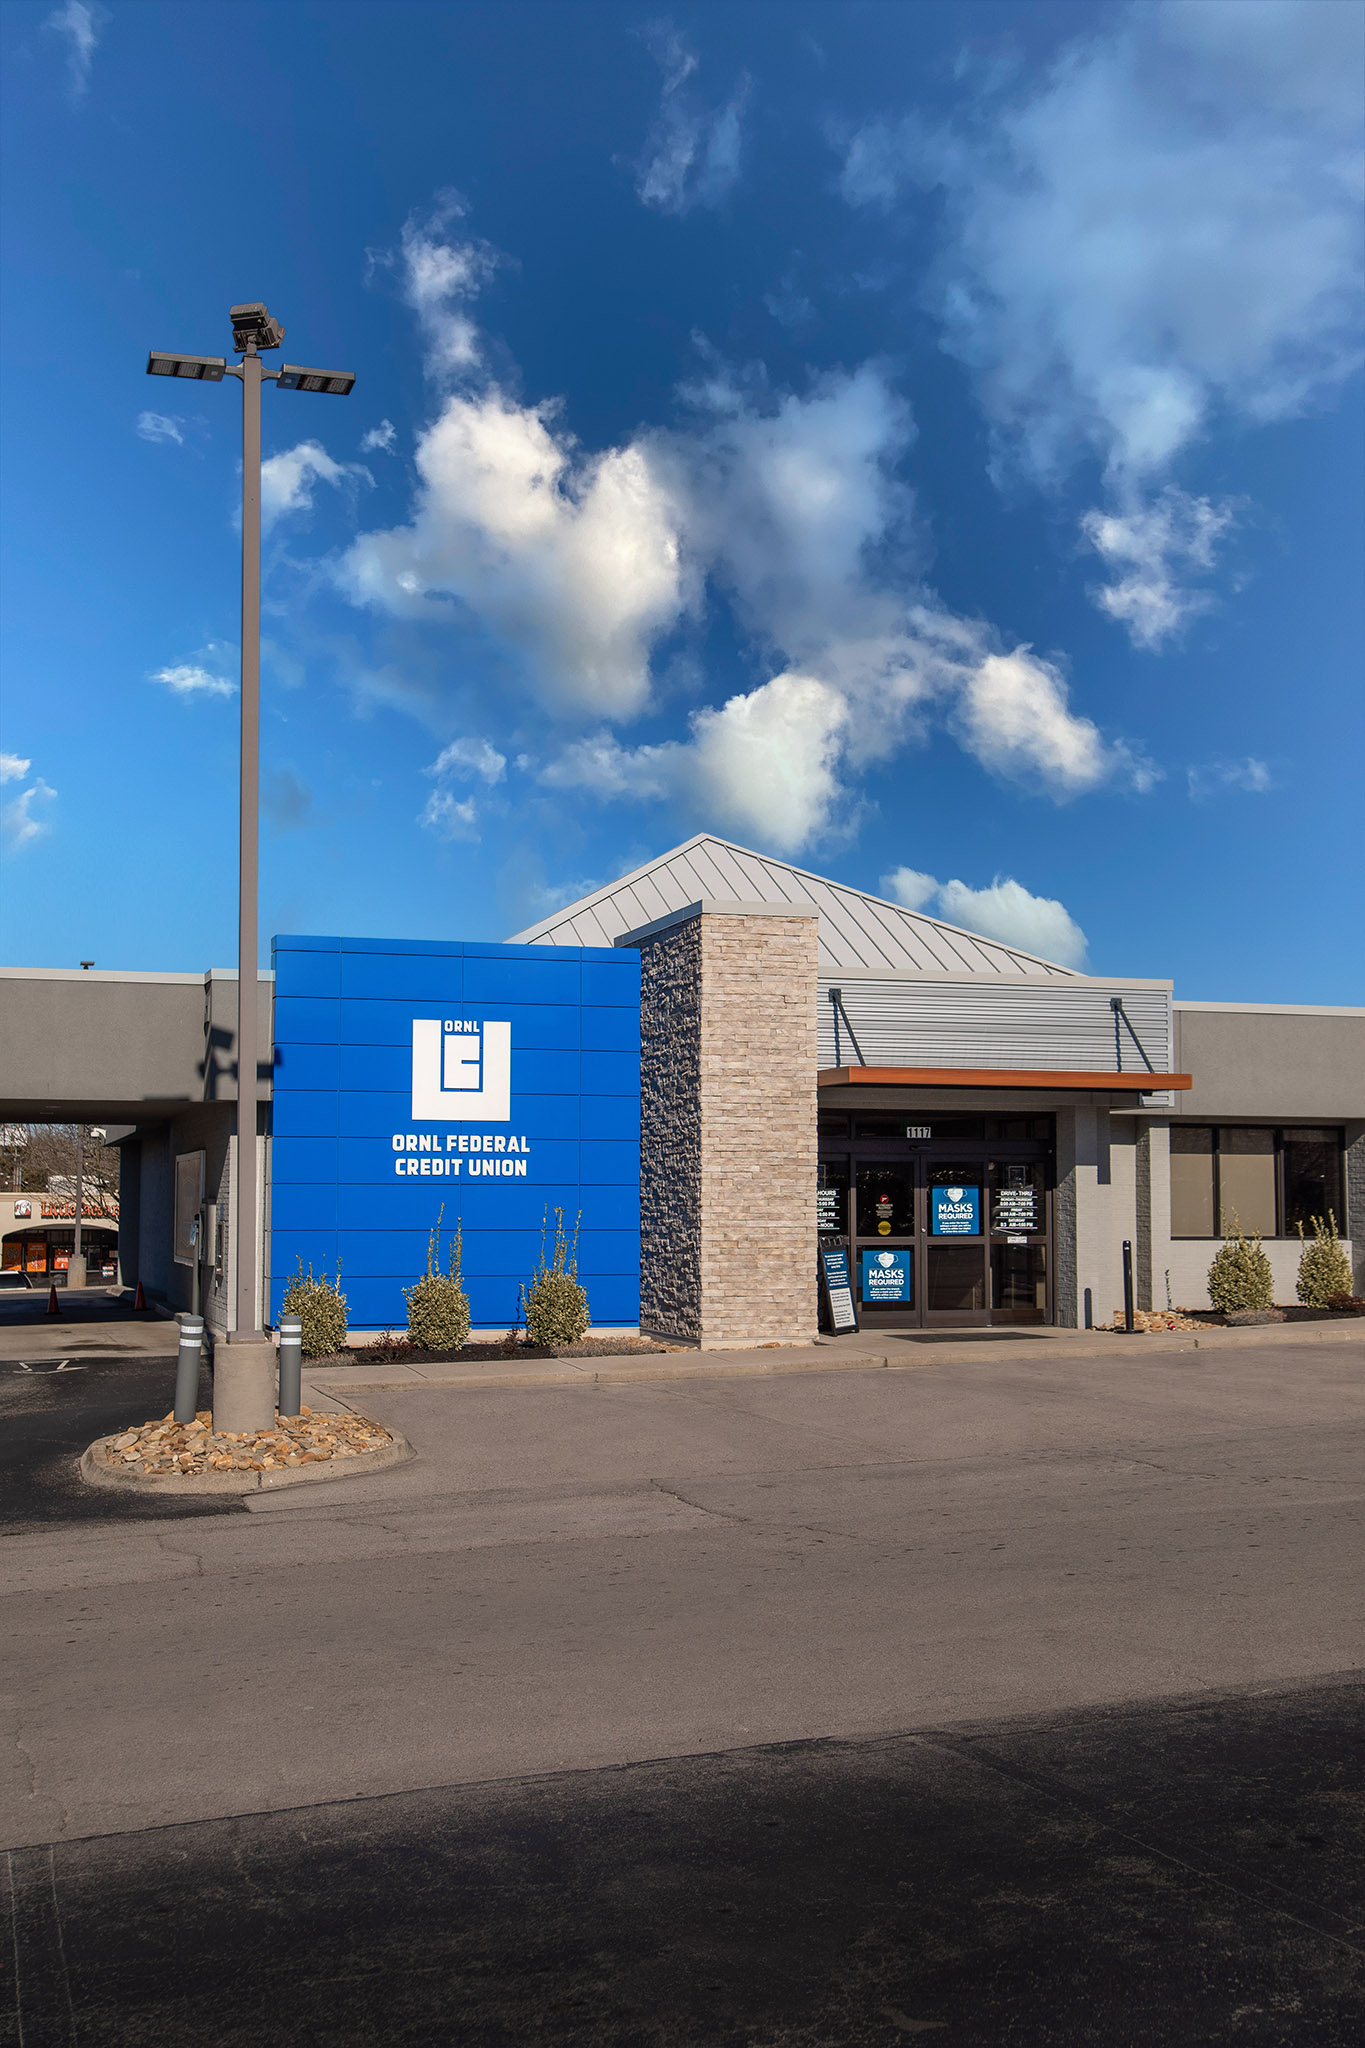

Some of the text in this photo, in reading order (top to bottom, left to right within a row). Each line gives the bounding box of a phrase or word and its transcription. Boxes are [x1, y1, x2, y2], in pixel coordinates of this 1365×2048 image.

[444, 1020, 480, 1033] ORNL
[908, 1127, 930, 1138] 1117
[392, 1134, 530, 1153] ORNL FEDERAL
[395, 1158, 527, 1177] CREDIT UNION
[41, 1202, 76, 1216] Little
[938, 1203, 973, 1213] MASKS
[868, 1269, 904, 1279] MASKS
[868, 1278, 905, 1286] REQUIRED
